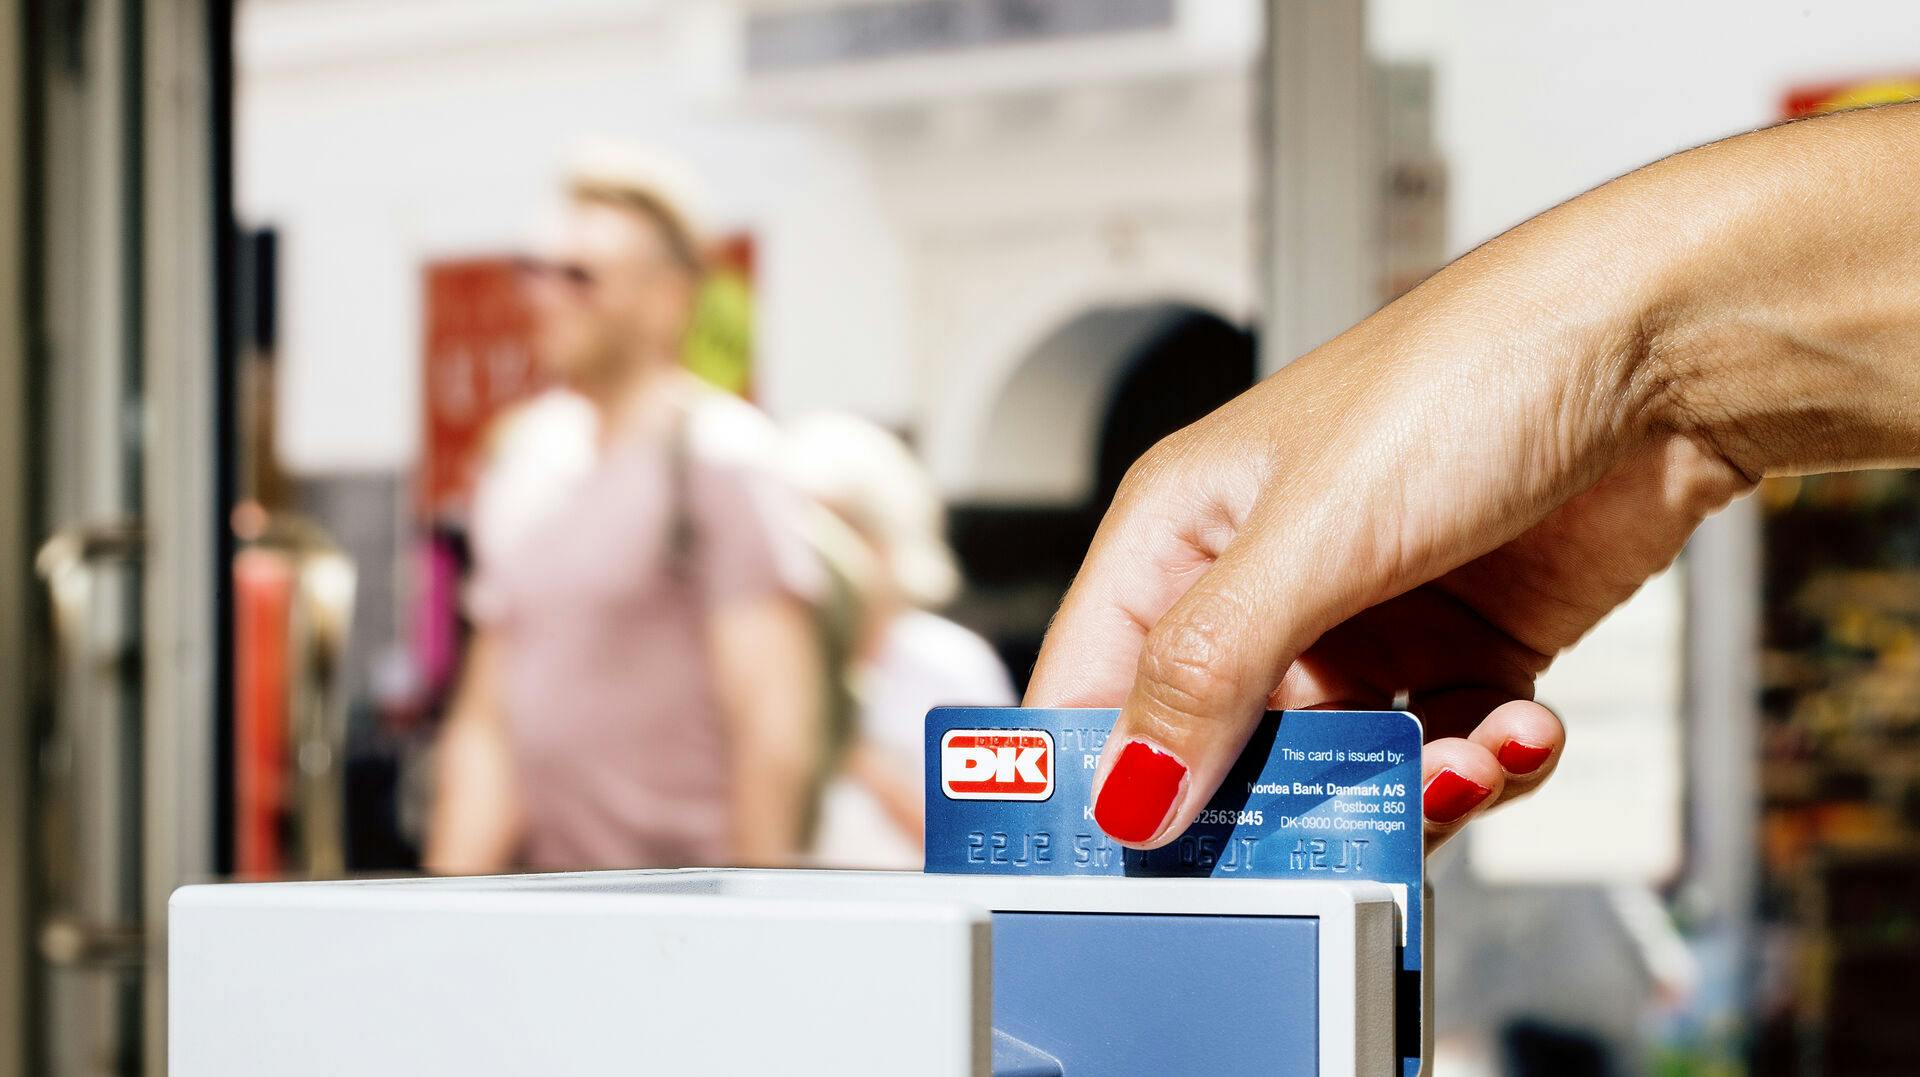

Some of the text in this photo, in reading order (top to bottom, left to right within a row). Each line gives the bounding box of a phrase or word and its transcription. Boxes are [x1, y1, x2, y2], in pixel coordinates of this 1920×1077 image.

[947, 747, 1048, 783] DK
[1282, 749, 1405, 765] This card is issued by:
[1247, 782, 1406, 797] Nordea Bank Danmark A/S
[1334, 801, 1405, 814] Postbox 850
[1280, 815, 1405, 834] DK-0900 Copenhagen
